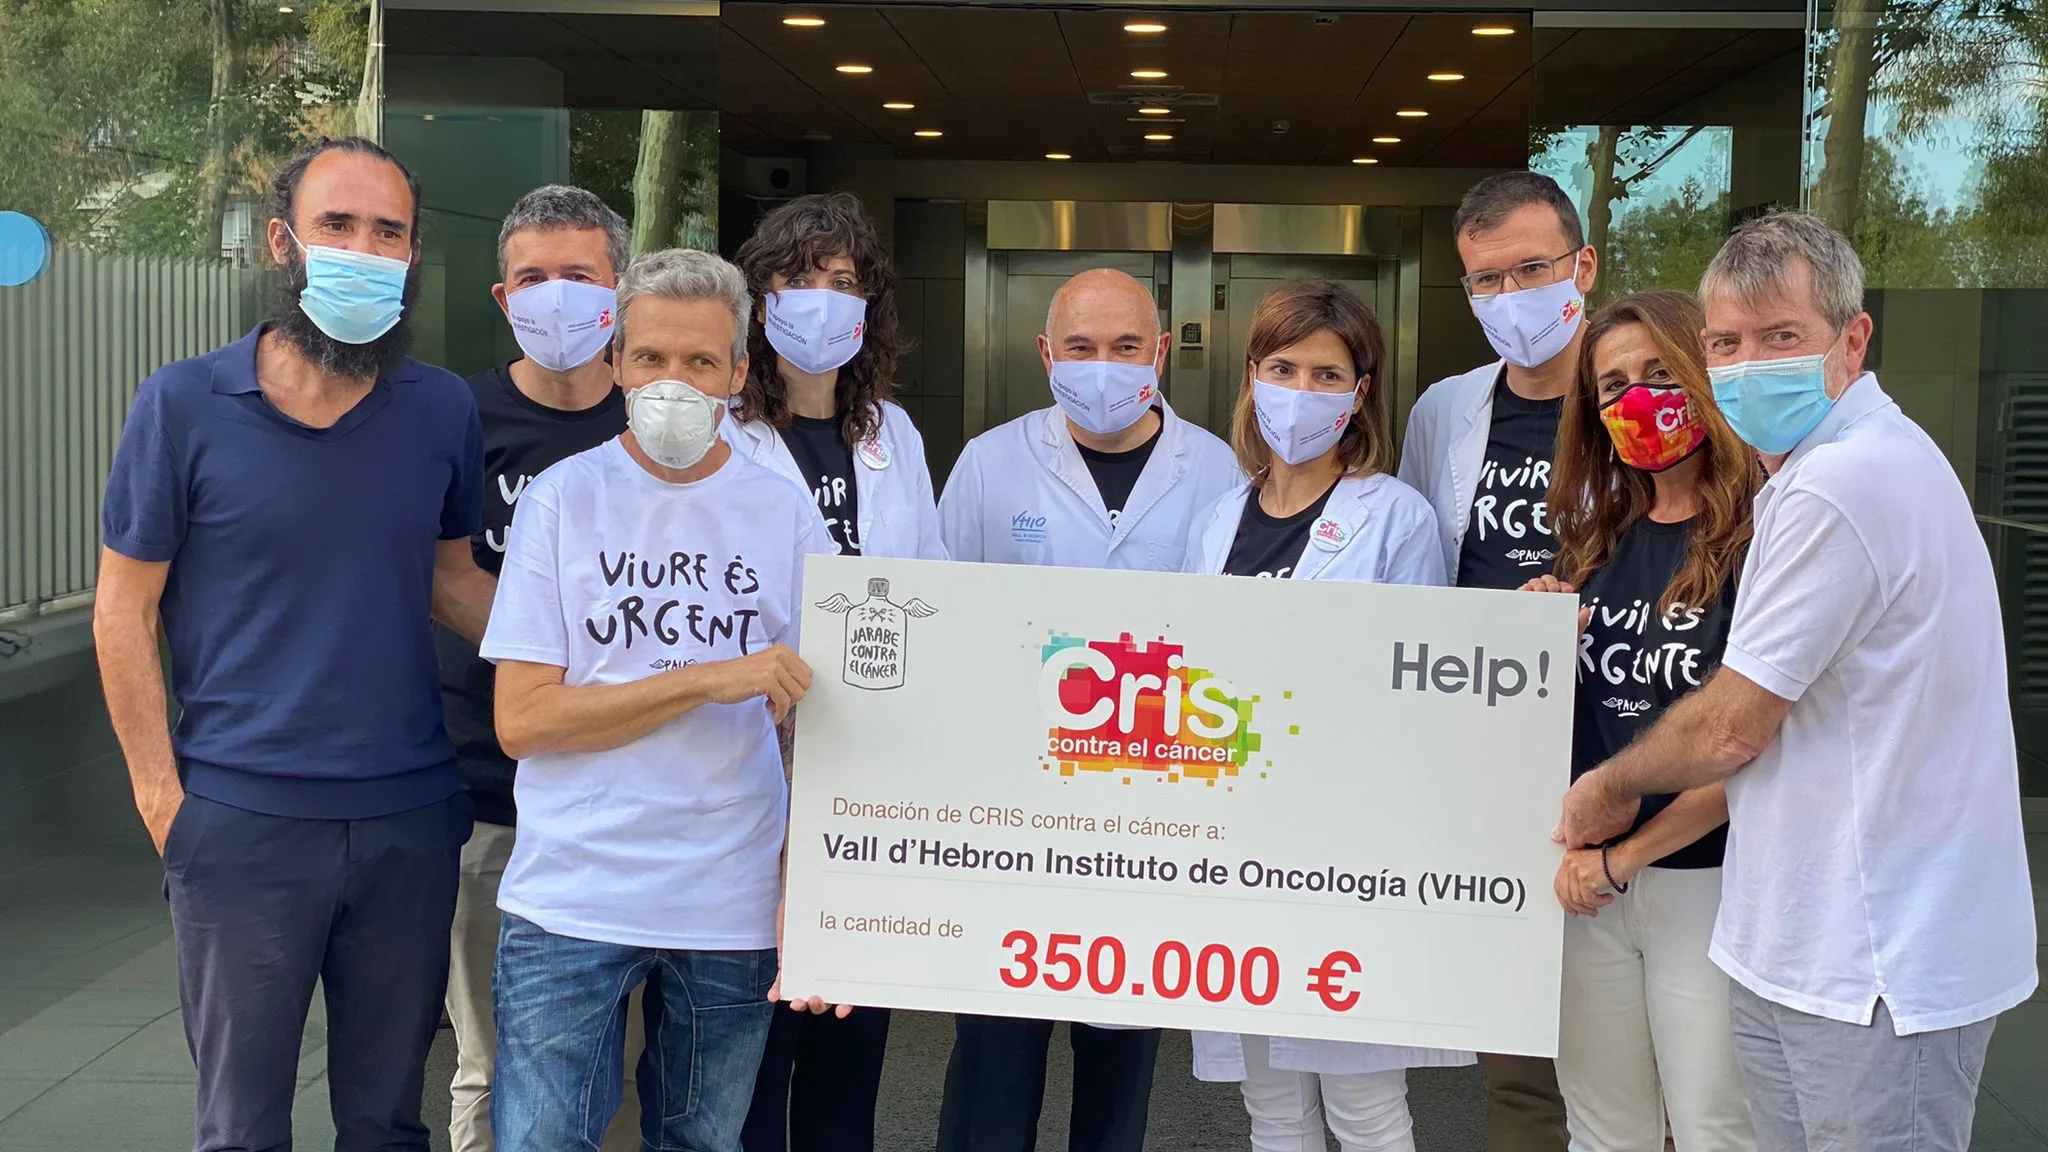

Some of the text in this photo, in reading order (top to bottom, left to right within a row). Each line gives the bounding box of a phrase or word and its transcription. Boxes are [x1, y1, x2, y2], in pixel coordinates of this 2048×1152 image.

[1012, 510, 1047, 528] VHIO
[1519, 549, 1541, 560] PAU
[586, 595, 759, 656] URGENT
[850, 627, 900, 647] JARABE
[851, 645, 897, 662] CONTRA
[1577, 634, 1702, 690] RGENTE
[1038, 646, 1239, 739] Cris
[1617, 698, 1639, 711] PAU
[1048, 736, 1237, 762] contra el cáncer
[832, 797, 1226, 840] Donación de CRIS contra el cáncer a:
[823, 833, 878, 862] Vall
[1045, 847, 1178, 882] Instituto
[1188, 857, 1229, 885] de
[1238, 860, 1407, 902] Oncología
[1417, 872, 1527, 912] (VHIO)
[820, 911, 964, 938] la cantidad de
[998, 929, 1363, 1012] 350.000 €
